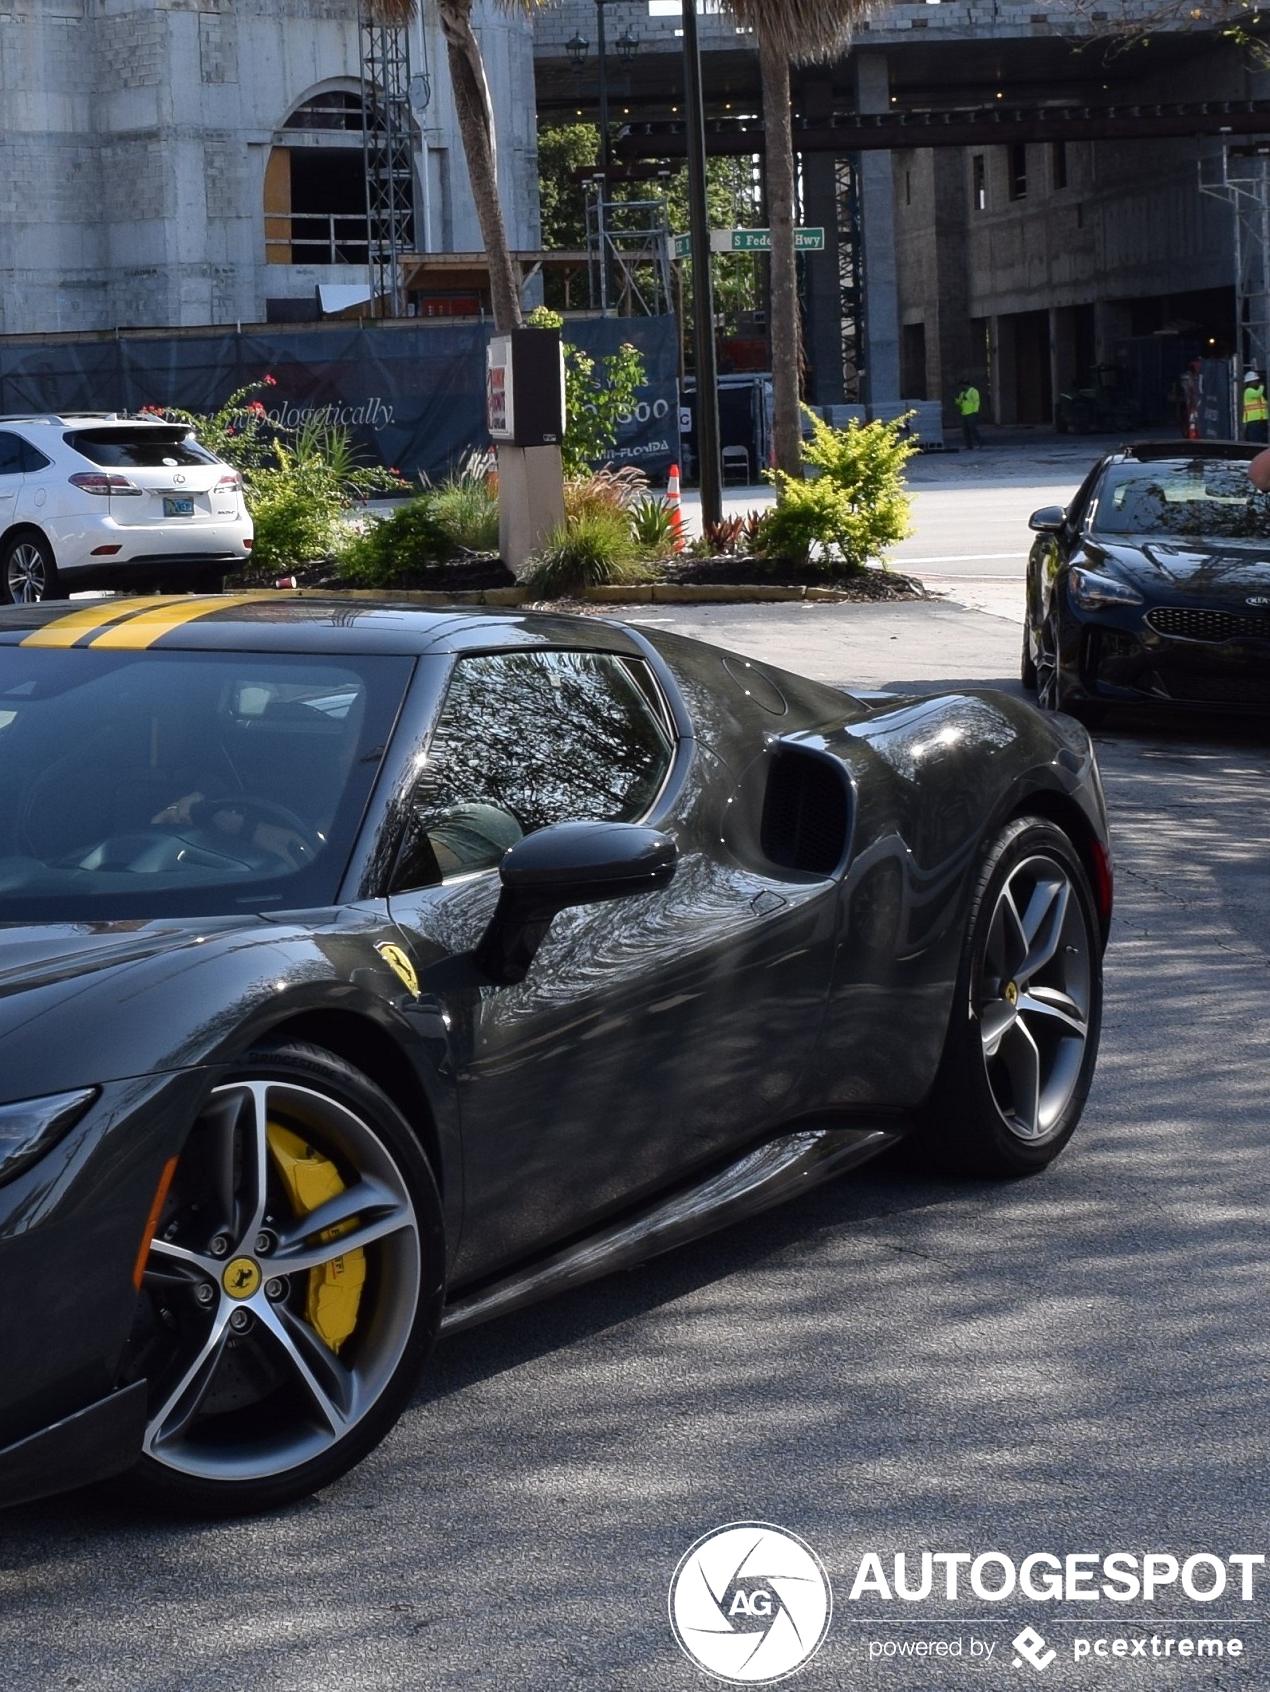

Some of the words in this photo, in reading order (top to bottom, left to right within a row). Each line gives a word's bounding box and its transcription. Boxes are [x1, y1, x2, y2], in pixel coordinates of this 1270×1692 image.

[734, 236, 741, 246] S
[746, 235, 772, 246] Fede
[795, 235, 821, 247] Hwy
